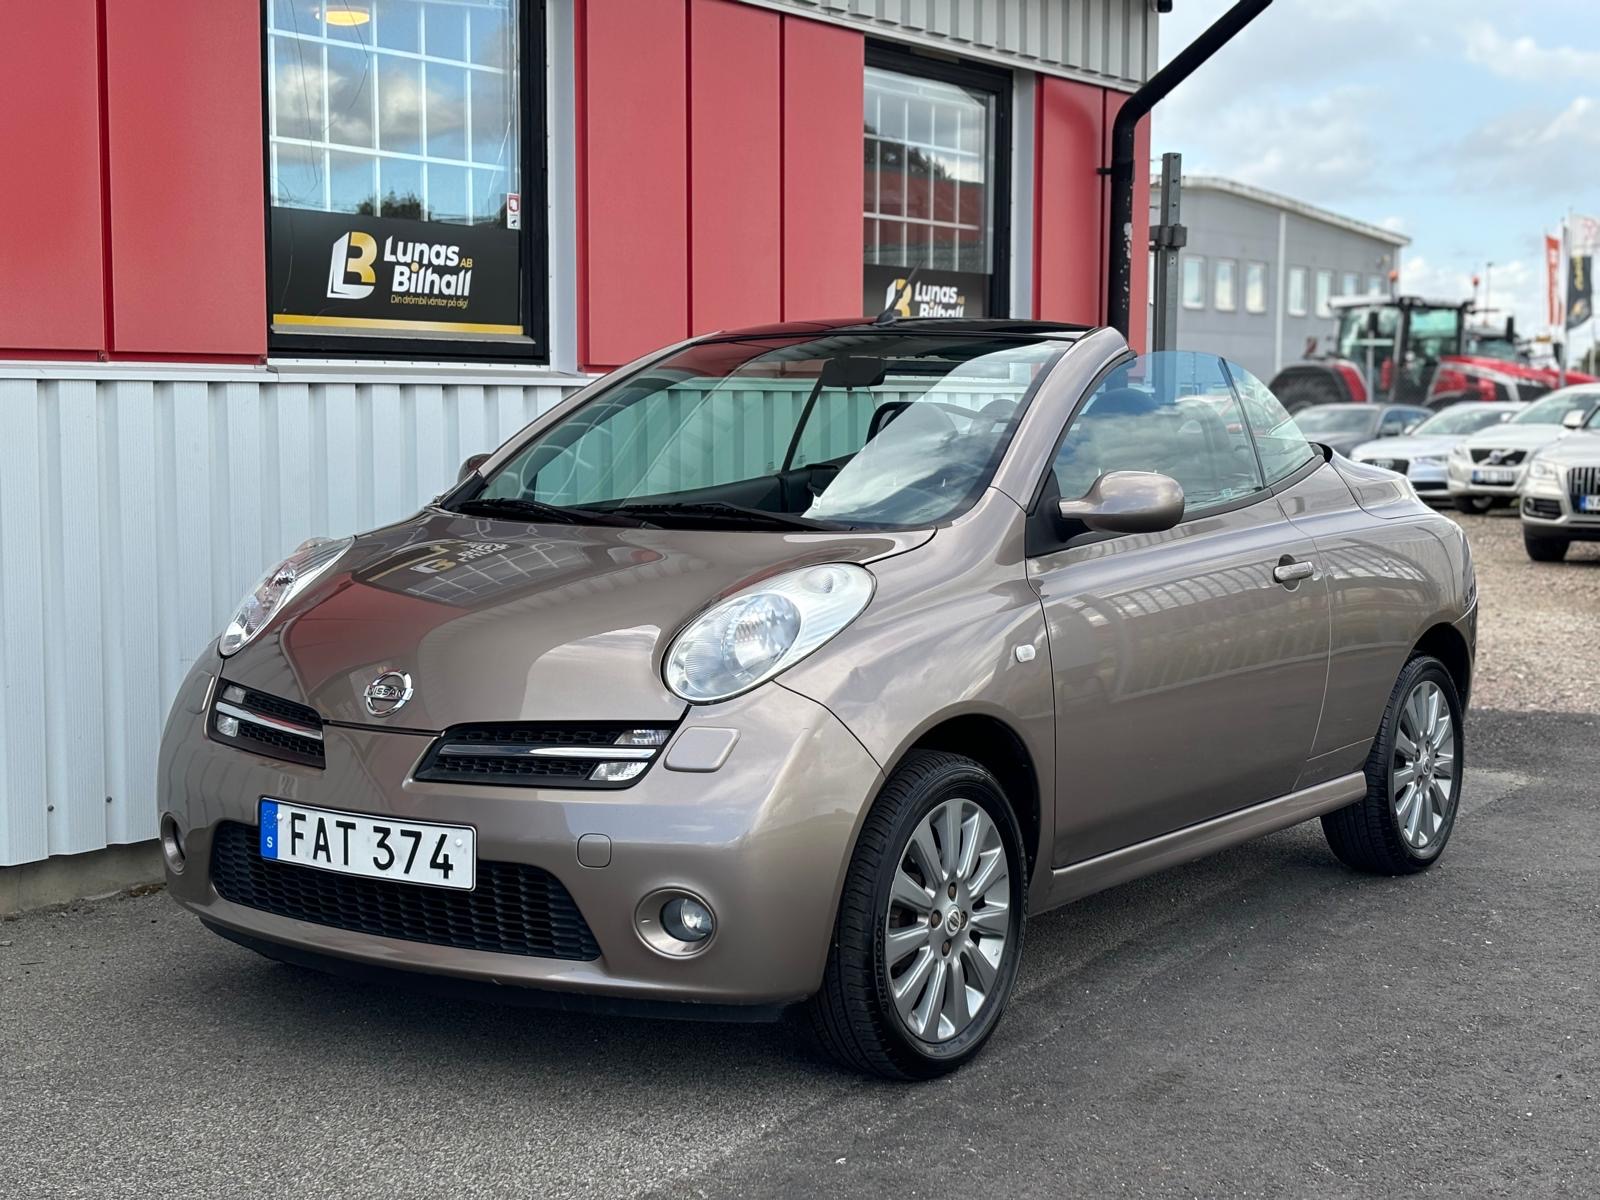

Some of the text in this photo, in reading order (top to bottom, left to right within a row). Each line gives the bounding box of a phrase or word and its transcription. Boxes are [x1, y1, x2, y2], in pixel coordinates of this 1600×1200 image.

[383, 235, 473, 269] Lunas AB
[392, 262, 472, 297] Bilhall
[390, 294, 402, 304] Din
[914, 281, 958, 304] Lunas
[367, 686, 404, 698] NISSAN
[266, 836, 273, 848] S
[290, 812, 454, 880] FAT 374
